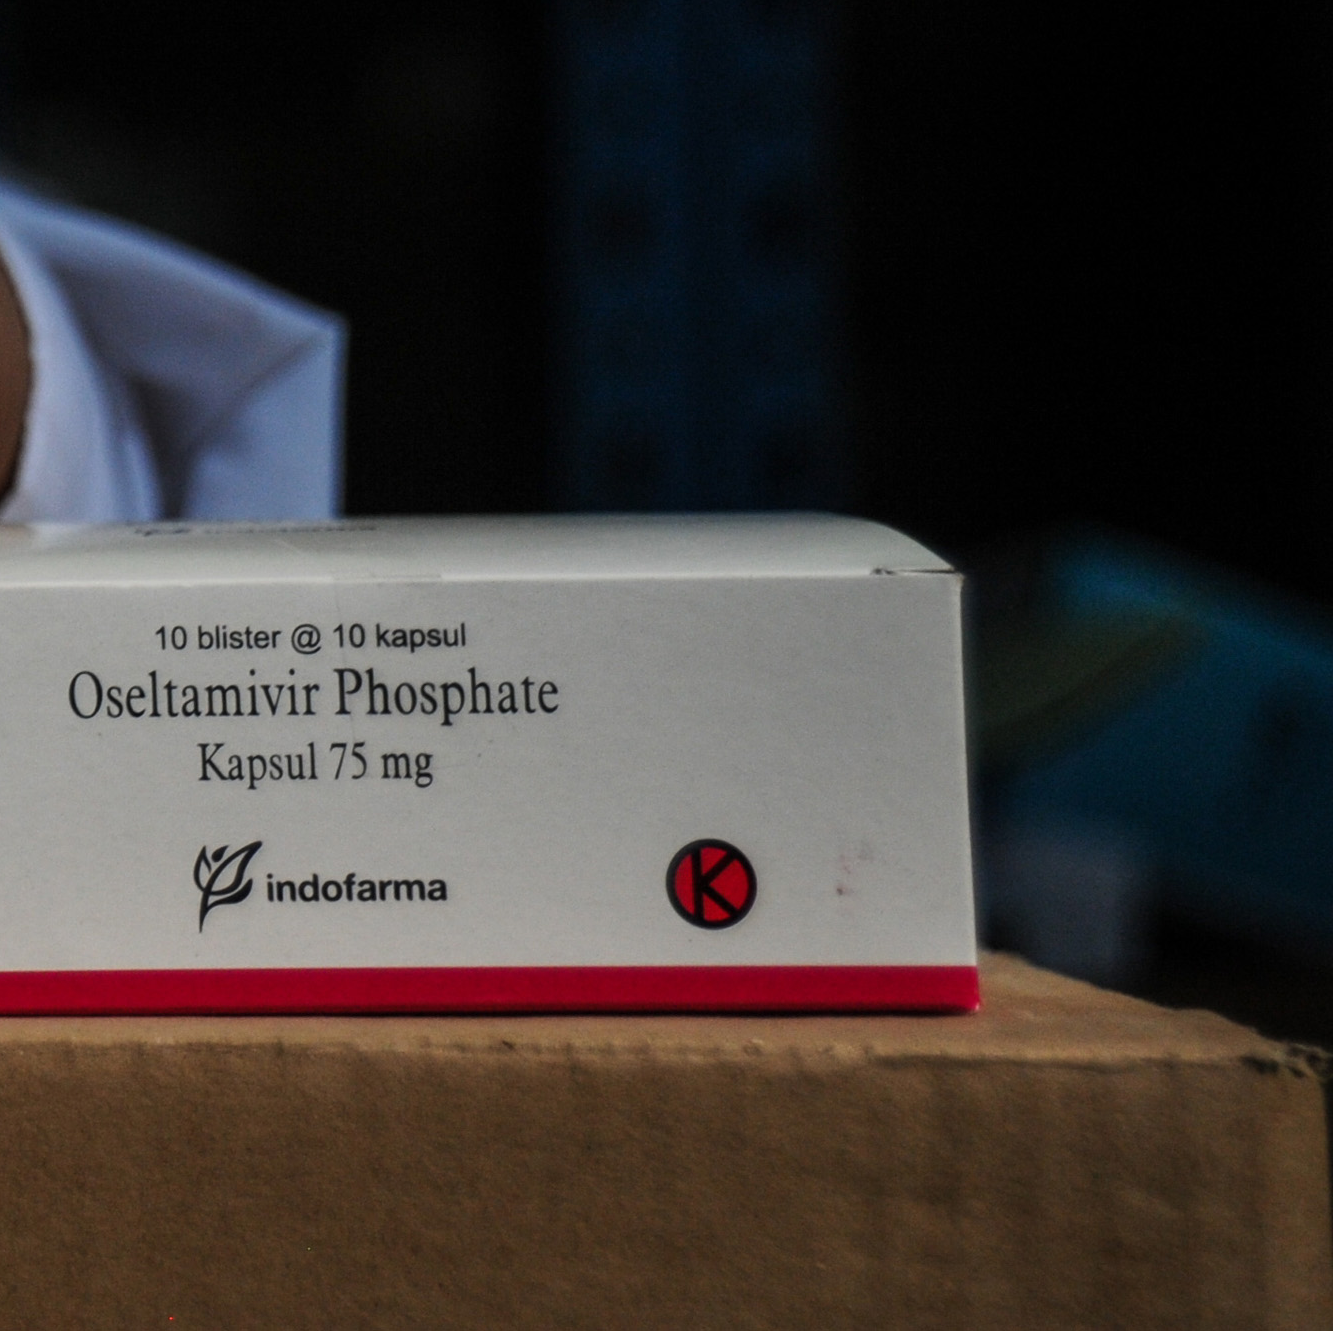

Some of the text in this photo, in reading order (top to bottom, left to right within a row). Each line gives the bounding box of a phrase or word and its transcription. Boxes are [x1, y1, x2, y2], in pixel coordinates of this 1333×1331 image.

[155, 622, 467, 656] 10 blister @ 10 kapsul
[68, 666, 559, 727] Oseltamivir Phosphate
[197, 741, 434, 791] Kapsul 75 mg
[266, 872, 448, 903] indofarma
